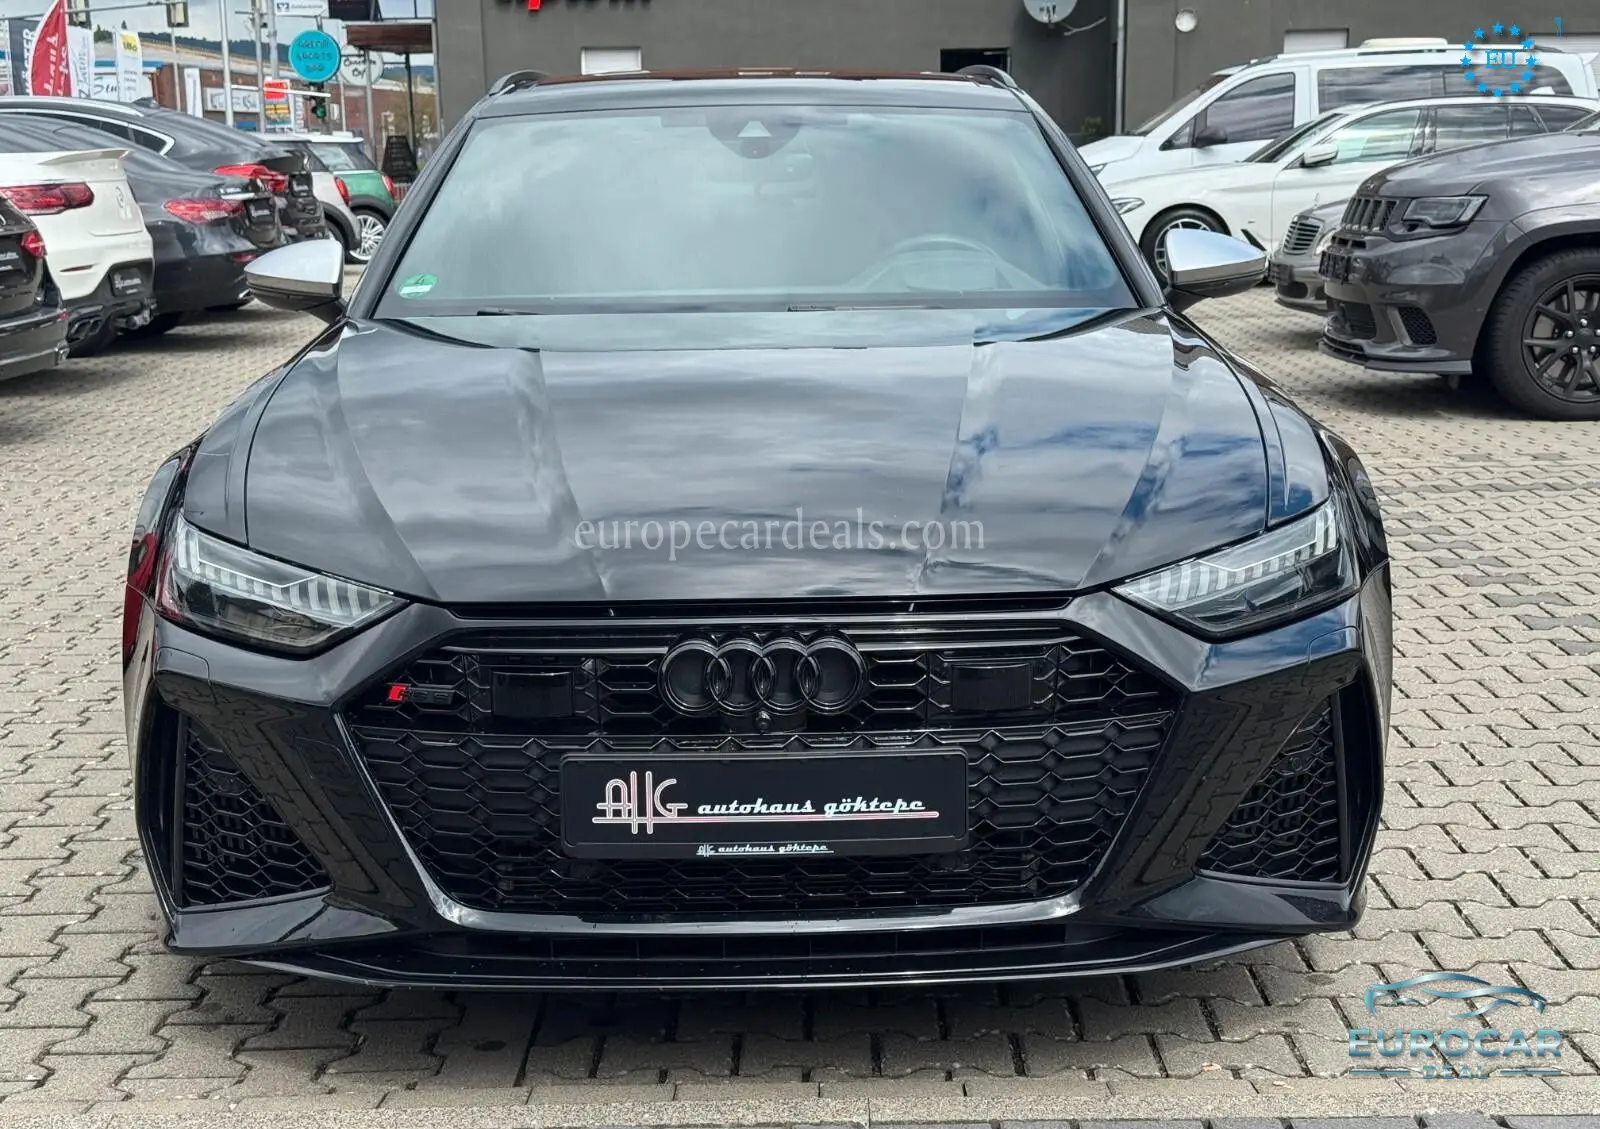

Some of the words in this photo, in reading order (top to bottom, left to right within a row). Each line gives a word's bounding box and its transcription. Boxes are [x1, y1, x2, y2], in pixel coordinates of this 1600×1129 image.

[698, 797, 816, 815] autohaus
[823, 796, 927, 817] göktepe
[718, 844, 775, 852] autohaus
[779, 843, 828, 854] göktepe
